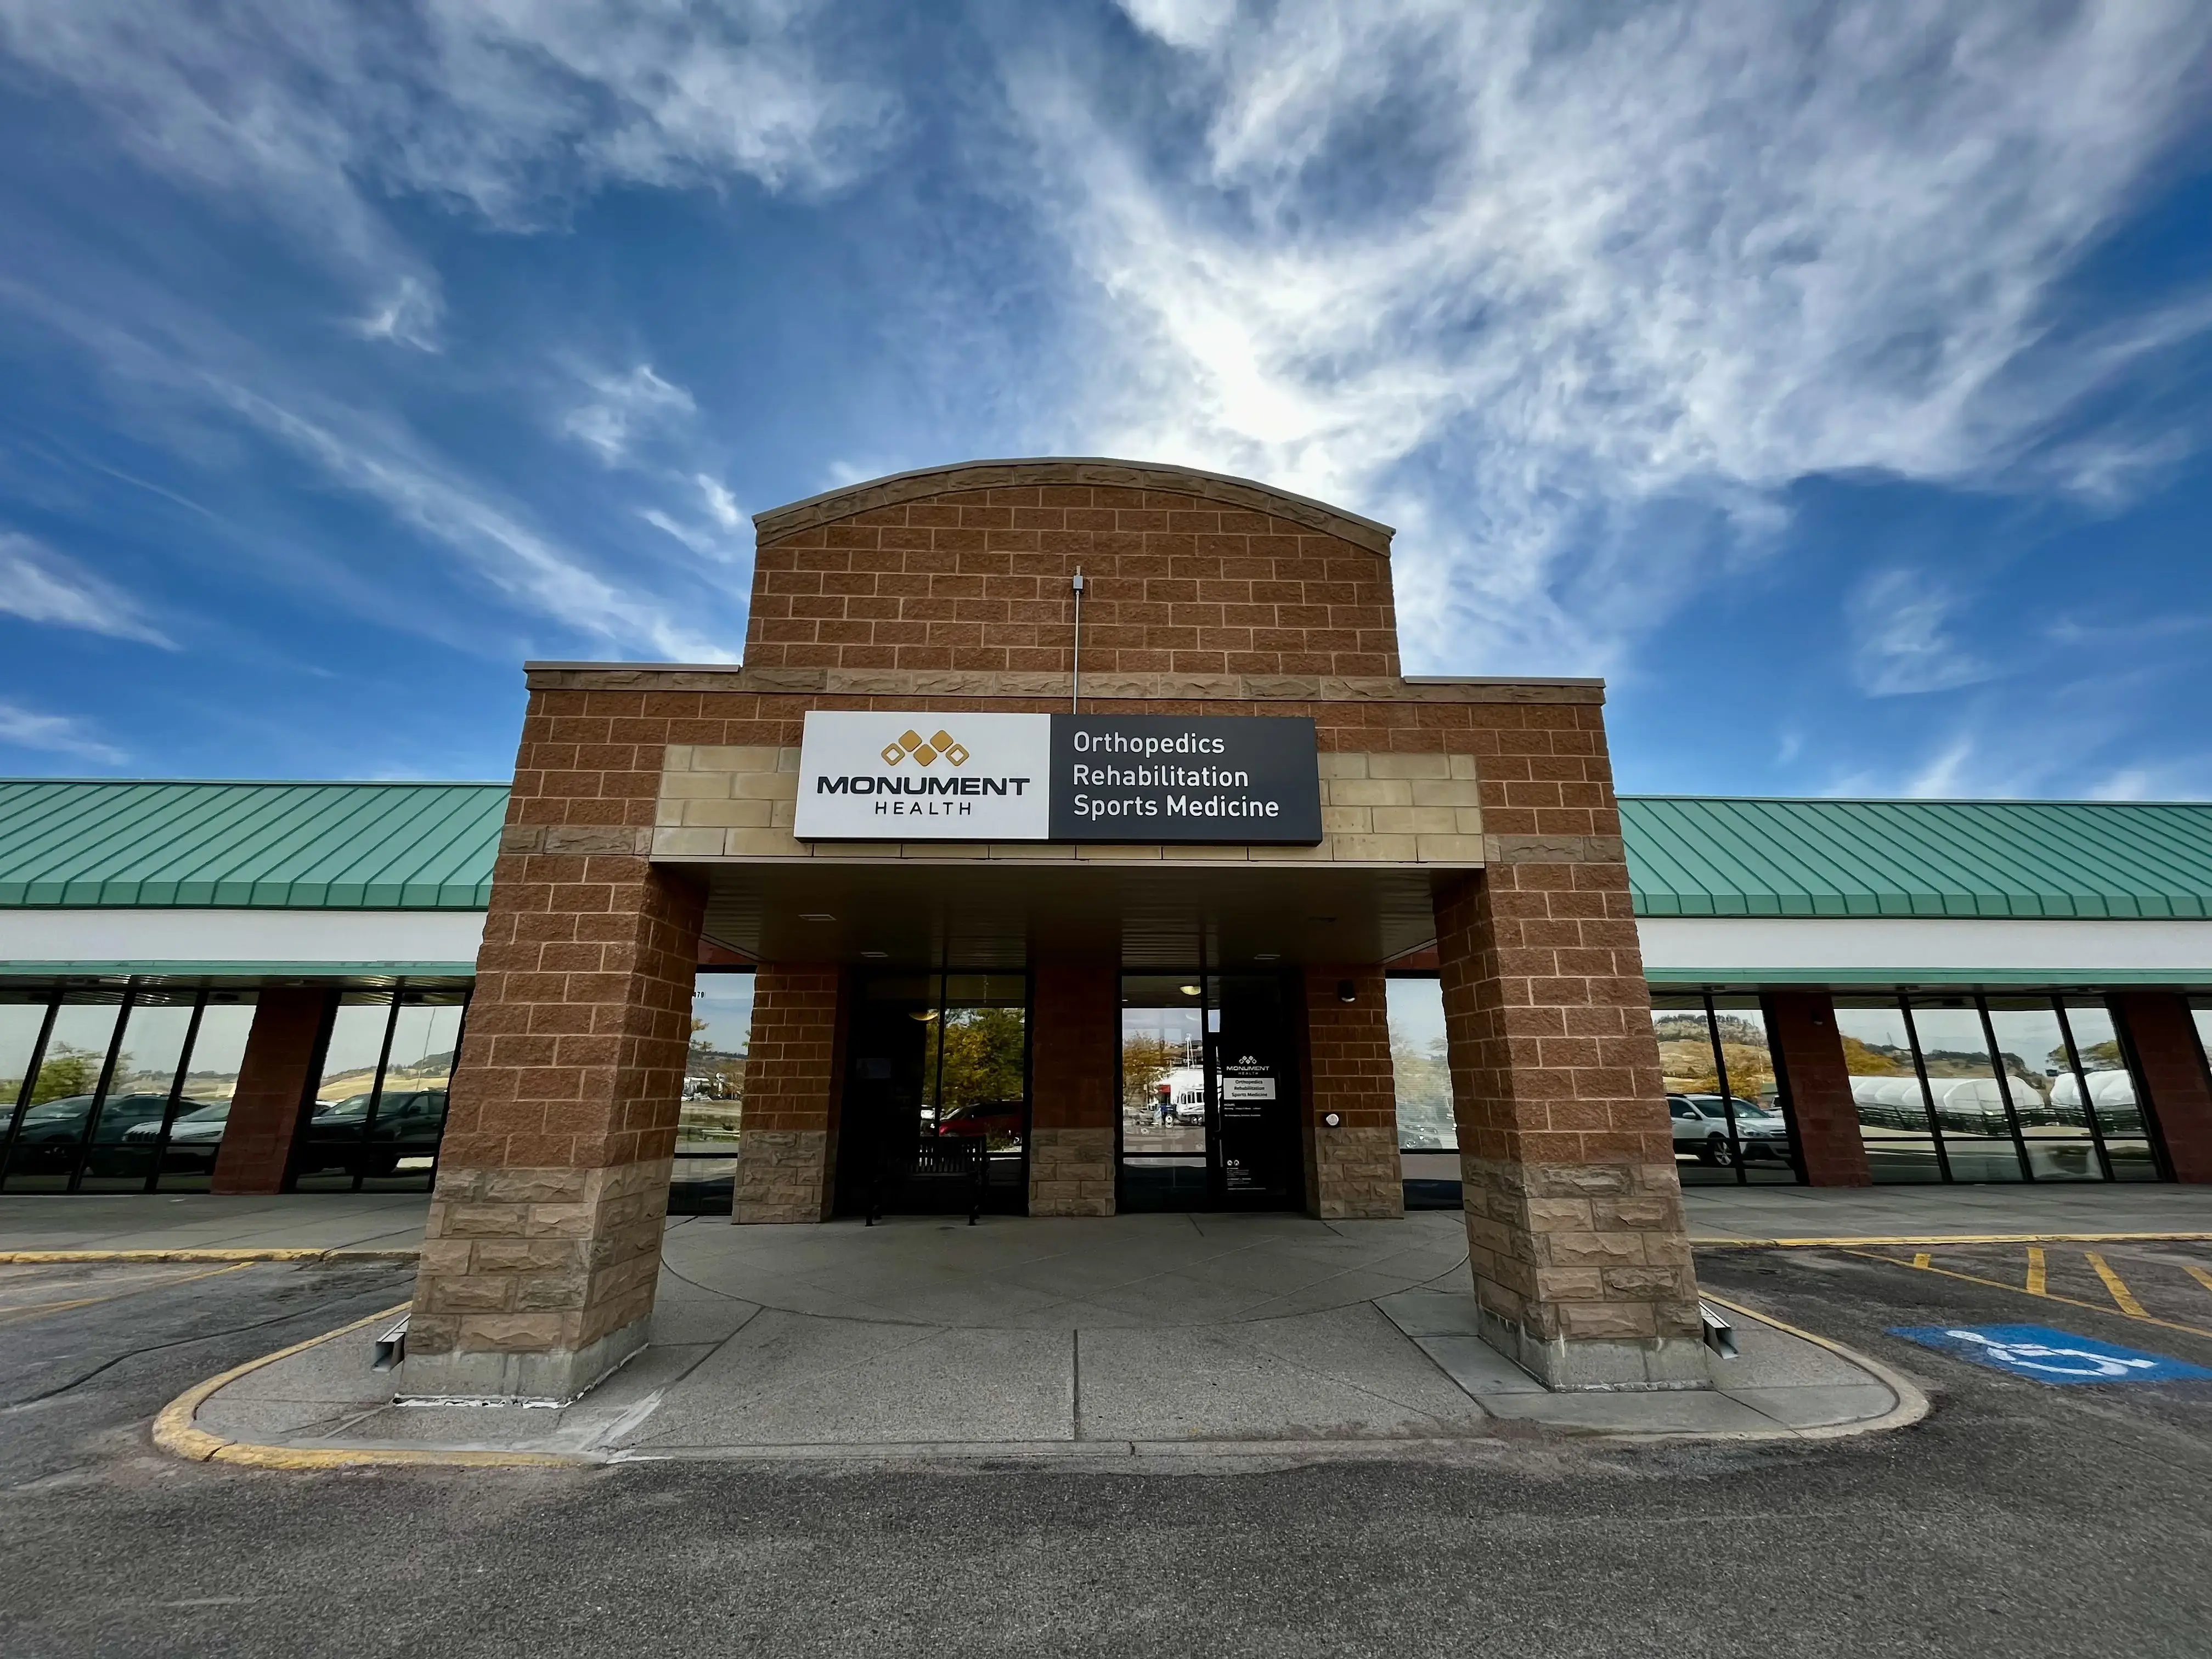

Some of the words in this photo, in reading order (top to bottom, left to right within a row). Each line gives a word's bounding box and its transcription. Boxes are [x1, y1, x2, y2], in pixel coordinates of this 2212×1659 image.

[1074, 731, 1224, 757] Orthopedics
[817, 776, 1030, 796] MONUMENT
[1074, 764, 1249, 787] Rehabilitation
[875, 801, 972, 815] HEALTH
[1074, 794, 1158, 821] Sports
[1166, 794, 1279, 817] Medicine
